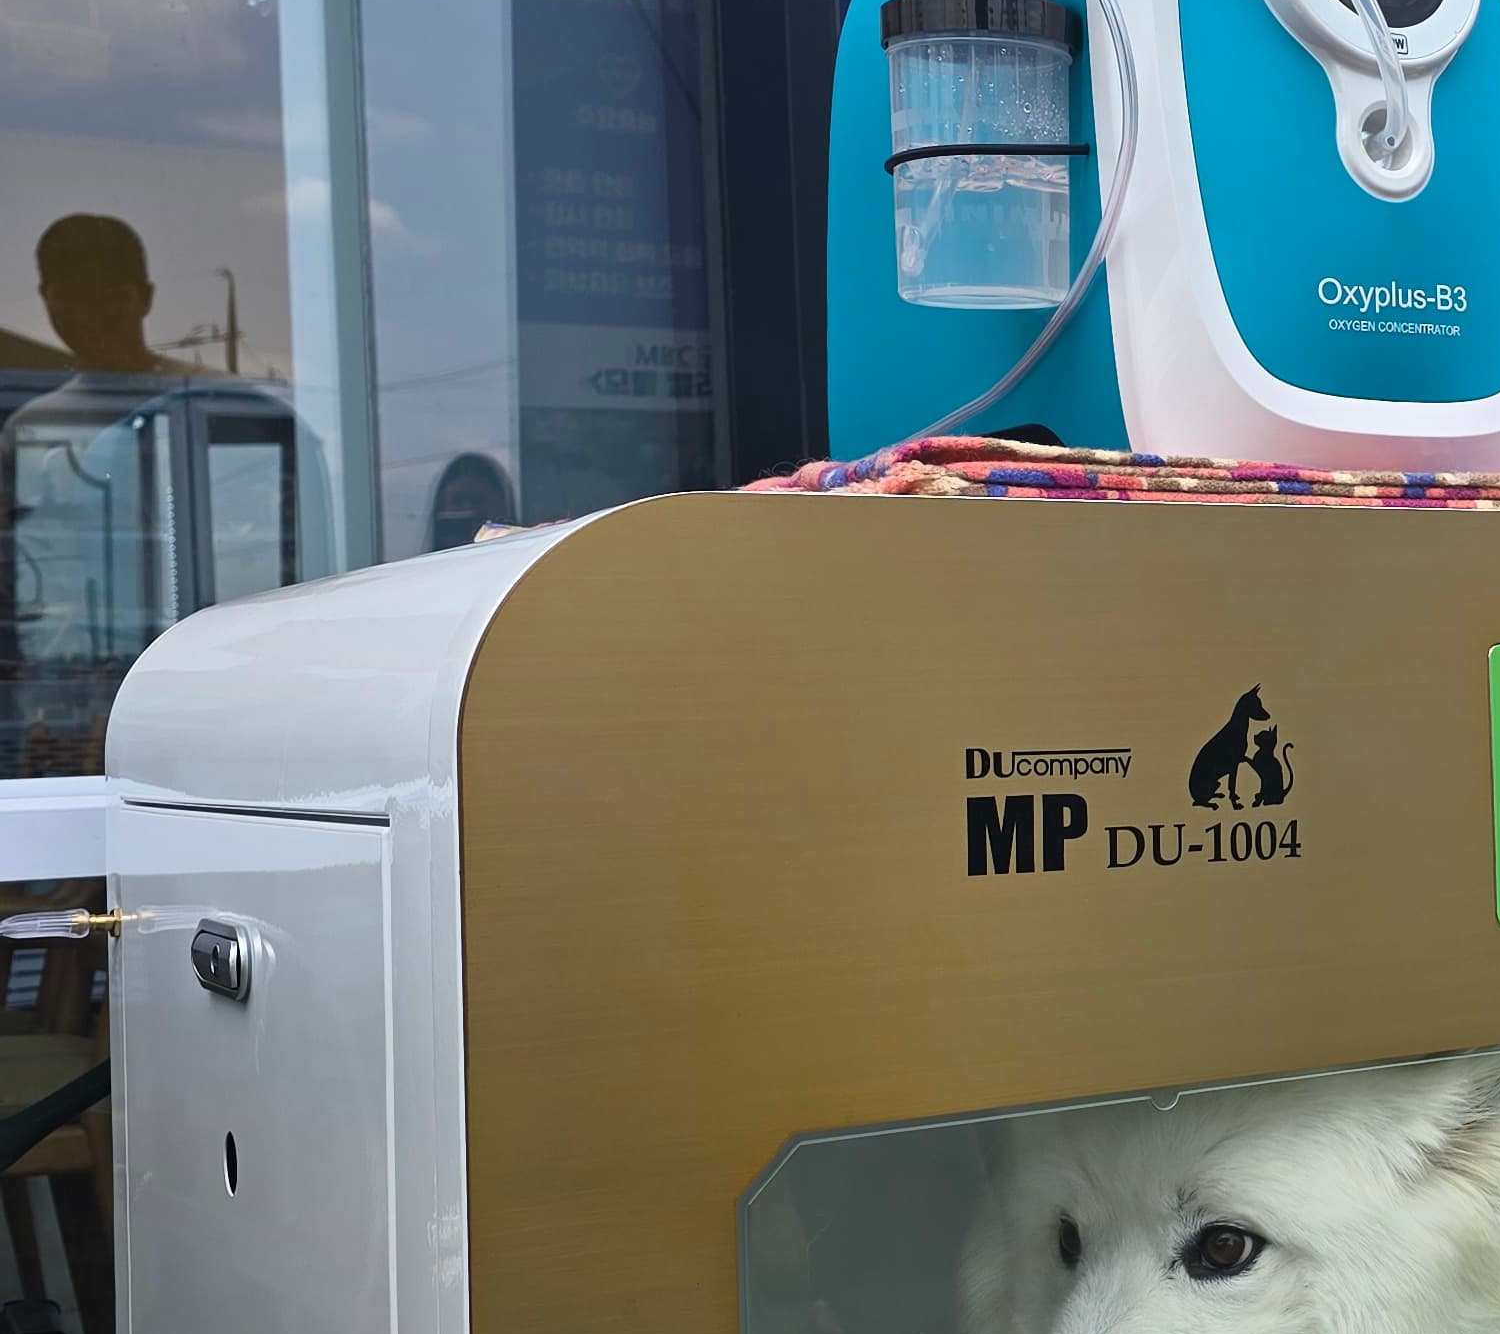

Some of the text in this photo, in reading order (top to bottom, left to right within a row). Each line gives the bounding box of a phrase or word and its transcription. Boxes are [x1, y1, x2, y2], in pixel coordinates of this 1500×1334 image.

[1318, 277, 1467, 312] Oxyplus-B3
[1329, 319, 1461, 337] OXYGEN CONCENTRATOR
[966, 748, 1131, 779] DUcompany
[966, 794, 1302, 876] MP DU-1004
